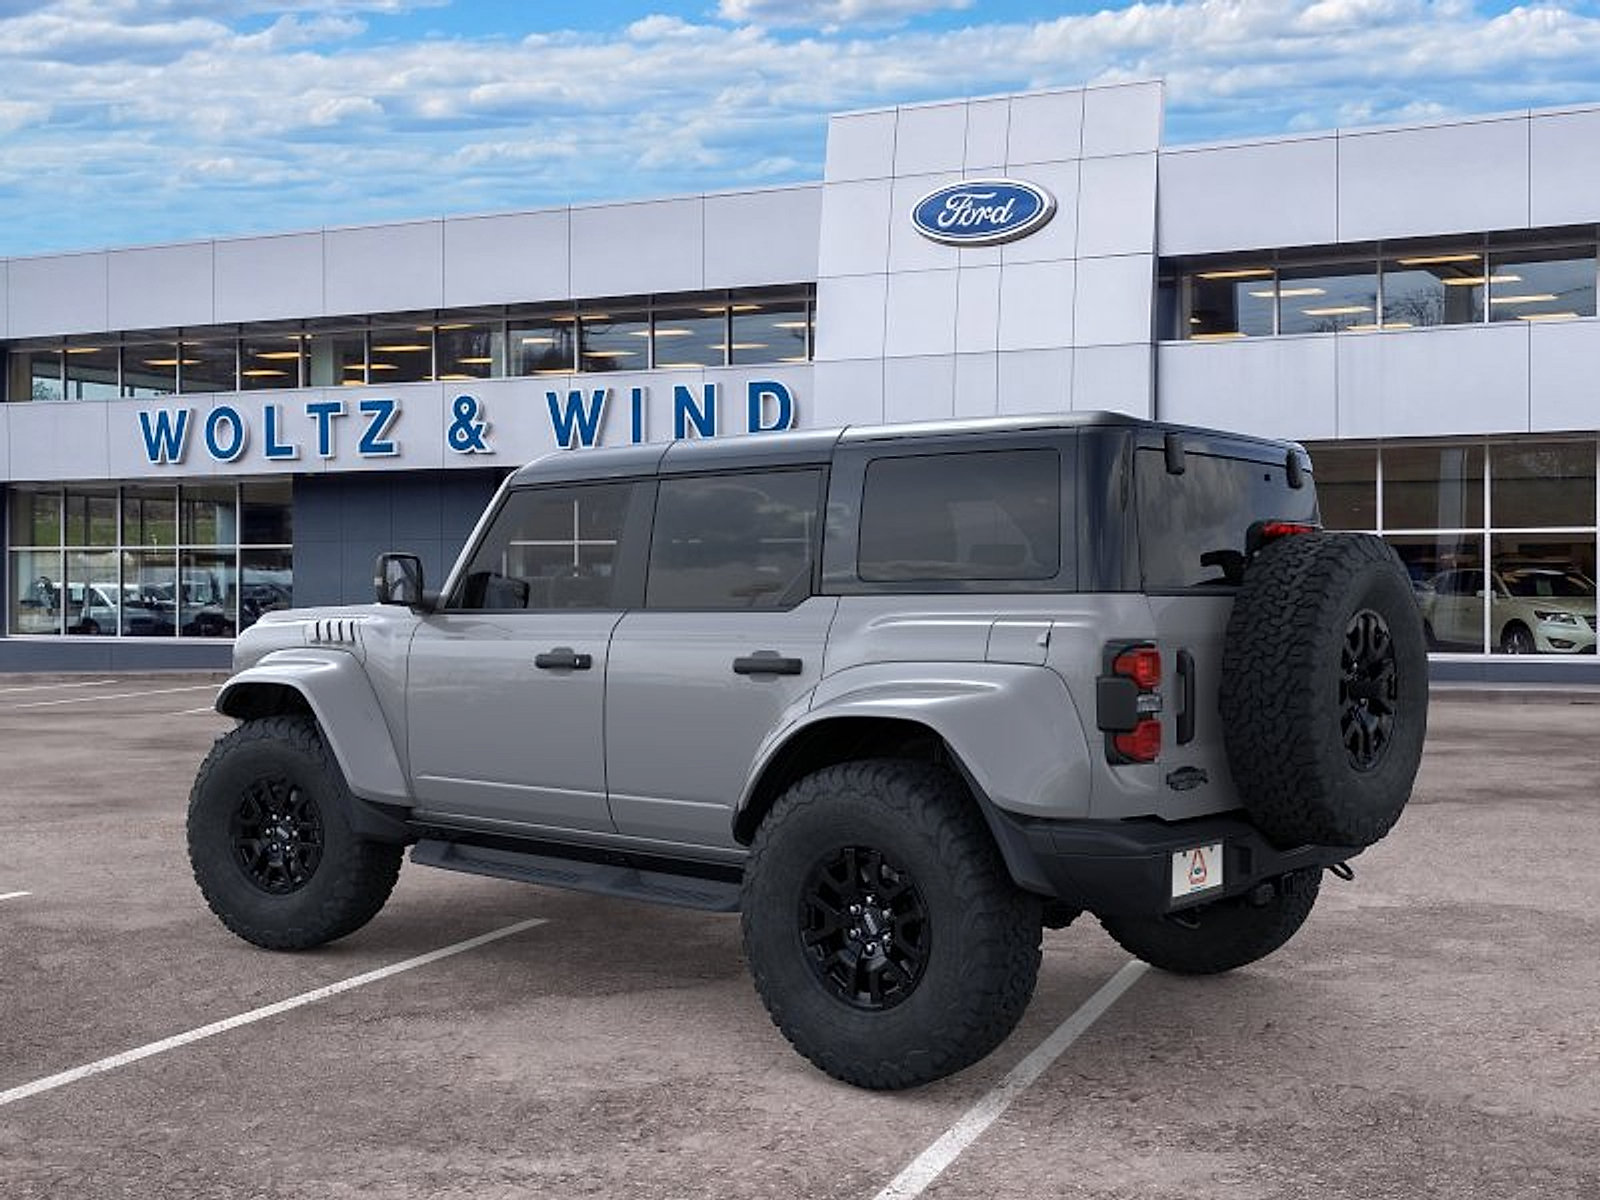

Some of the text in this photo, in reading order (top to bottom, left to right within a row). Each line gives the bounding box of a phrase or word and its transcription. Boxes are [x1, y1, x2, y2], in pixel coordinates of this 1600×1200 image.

[938, 192, 1016, 227] Ford
[138, 380, 795, 464] WOLTZ & WIND
